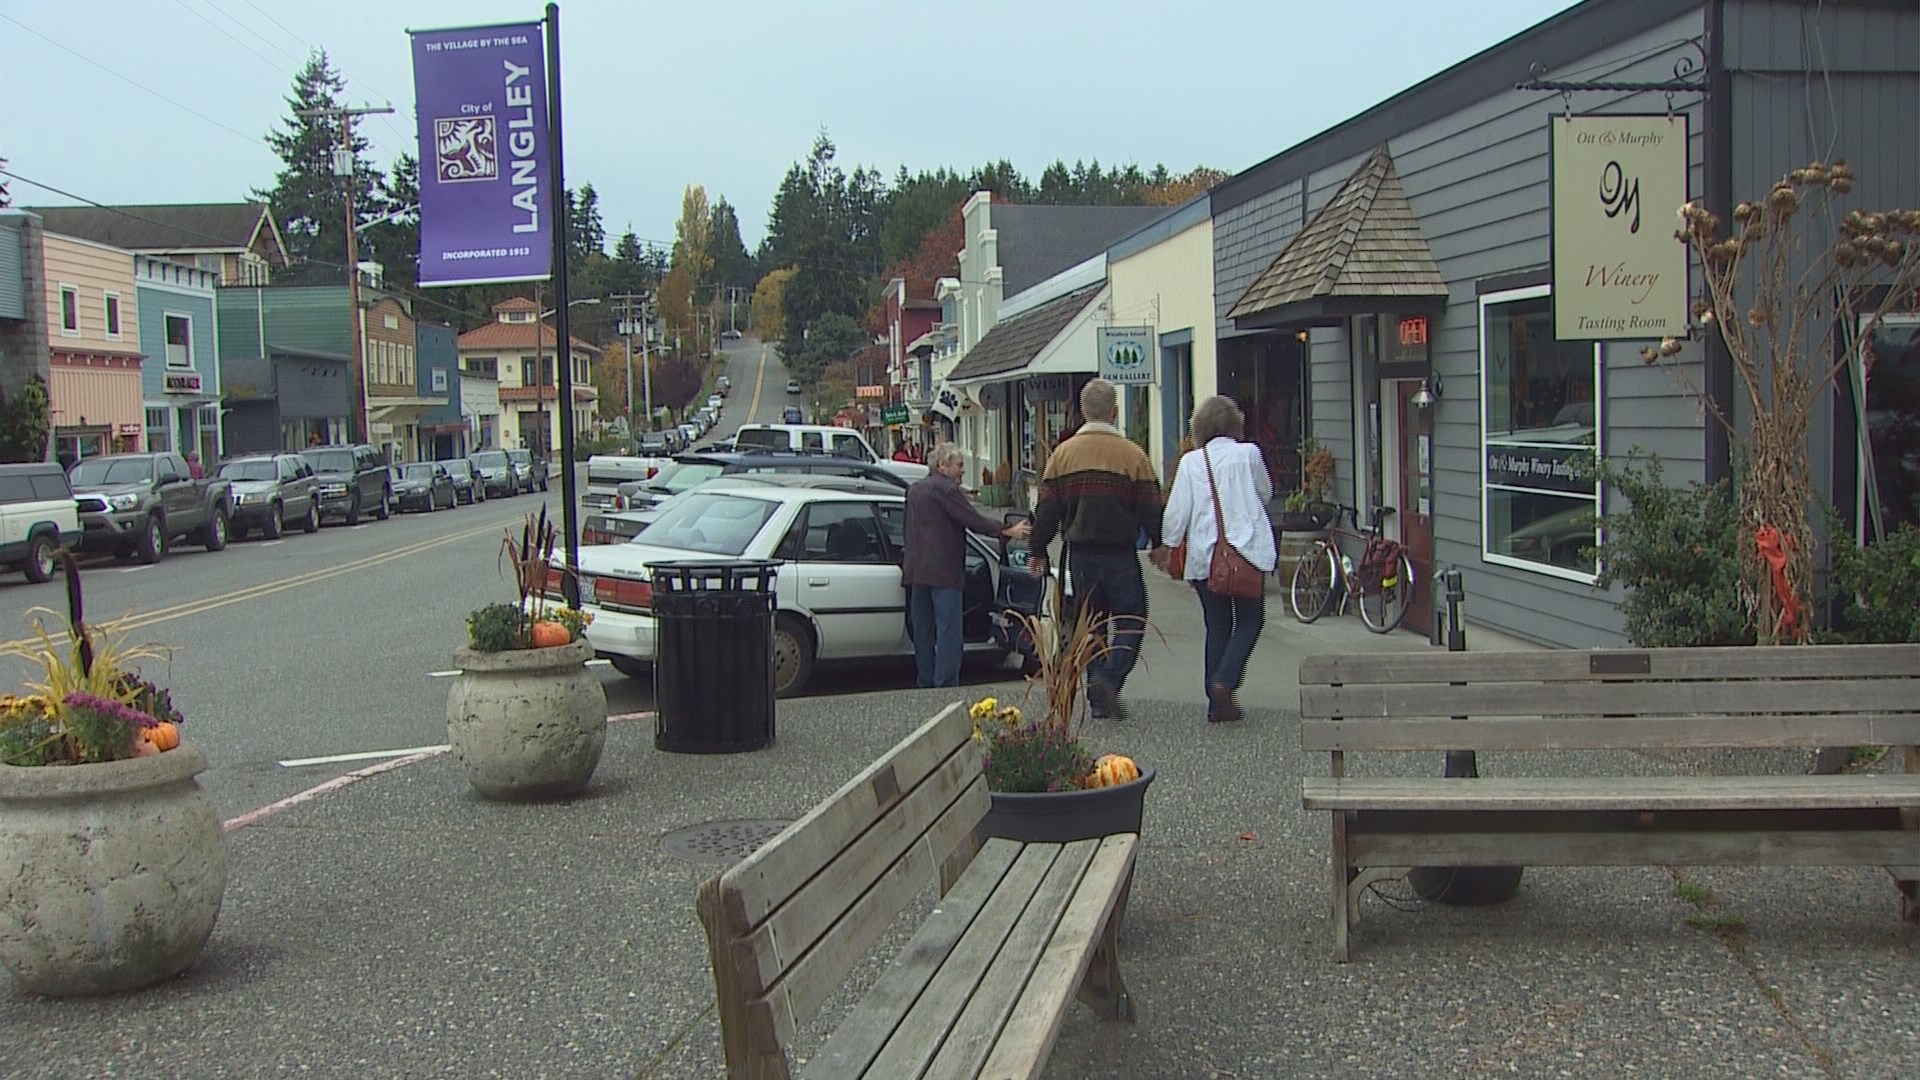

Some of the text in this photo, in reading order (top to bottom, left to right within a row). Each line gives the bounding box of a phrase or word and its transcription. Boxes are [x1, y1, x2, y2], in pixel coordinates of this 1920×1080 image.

[426, 35, 528, 52] THE VILLAGE BY THE SEA
[461, 102, 493, 114] City of
[504, 59, 538, 233] LANGLEY
[1577, 132, 1596, 145] Ott
[1618, 131, 1664, 147] Murphy
[442, 247, 530, 260] INCORPORATED 1913
[1584, 262, 1660, 305] Winery
[1400, 318, 1428, 346] OPEN
[1578, 315, 1667, 333] Tasting Room
[1508, 455, 1530, 477] Murphy
[1531, 457, 1552, 479] Winery
